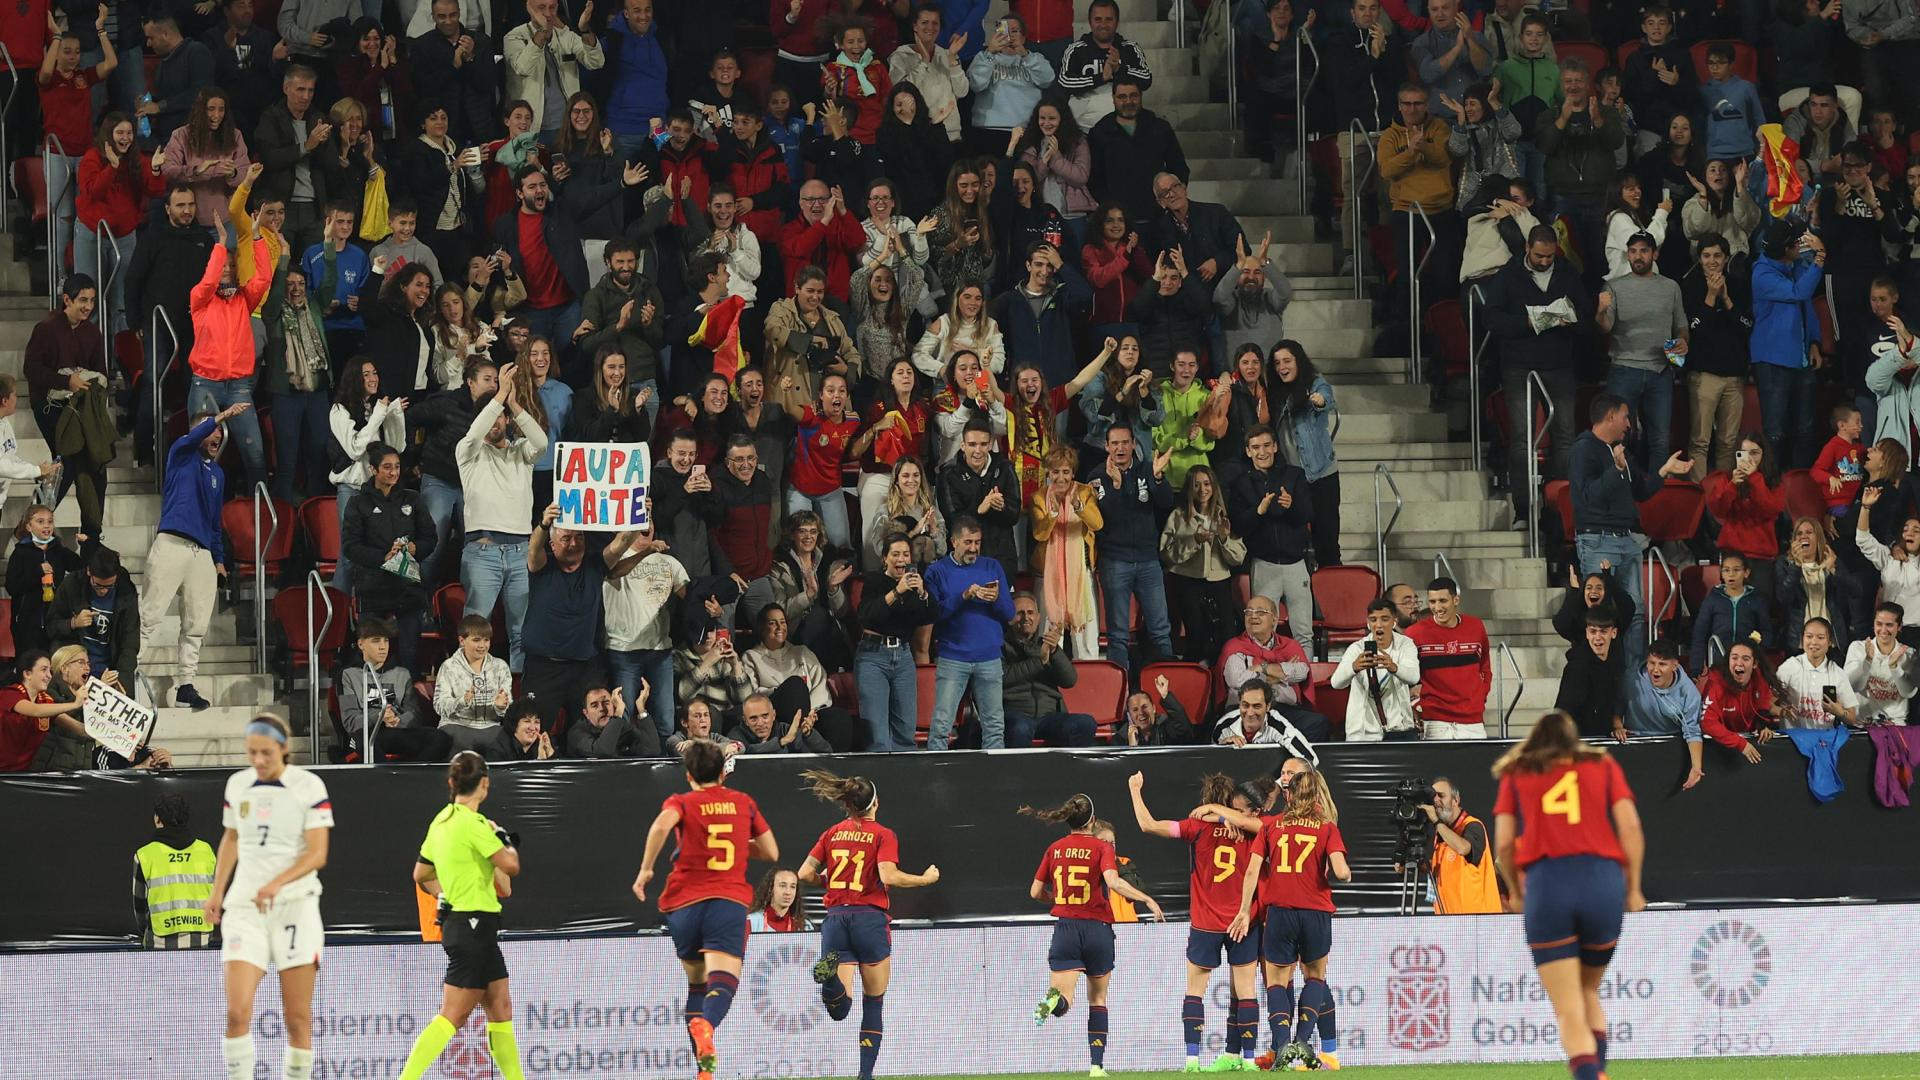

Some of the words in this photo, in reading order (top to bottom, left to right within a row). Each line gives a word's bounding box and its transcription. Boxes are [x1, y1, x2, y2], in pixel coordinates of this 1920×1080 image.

[87, 682, 149, 732] ESTHER
[94, 706, 107, 718] ME
[107, 714, 120, 726] DAS
[700, 802, 736, 816] IVANA
[1541, 770, 1581, 825] 4
[257, 825, 269, 847] 7
[706, 823, 736, 871] 5
[830, 830, 875, 844] ZORNOZA
[168, 852, 192, 863] 257
[1065, 847, 1092, 860] OROZ
[1213, 845, 1237, 883] 9
[1276, 833, 1318, 873] 17
[829, 849, 866, 892] 21
[1053, 865, 1091, 905] 15
[163, 915, 204, 929] STEWARD
[284, 924, 297, 950] 7
[1471, 971, 1655, 1002] Nafaako
[257, 1008, 415, 1039] Gbierno
[526, 997, 687, 1030] Nafarroak
[1691, 1032, 1775, 1055] 2030
[311, 1054, 408, 1080] avarr
[526, 1044, 691, 1072] Gobernua
[754, 1057, 837, 1077] 2030
